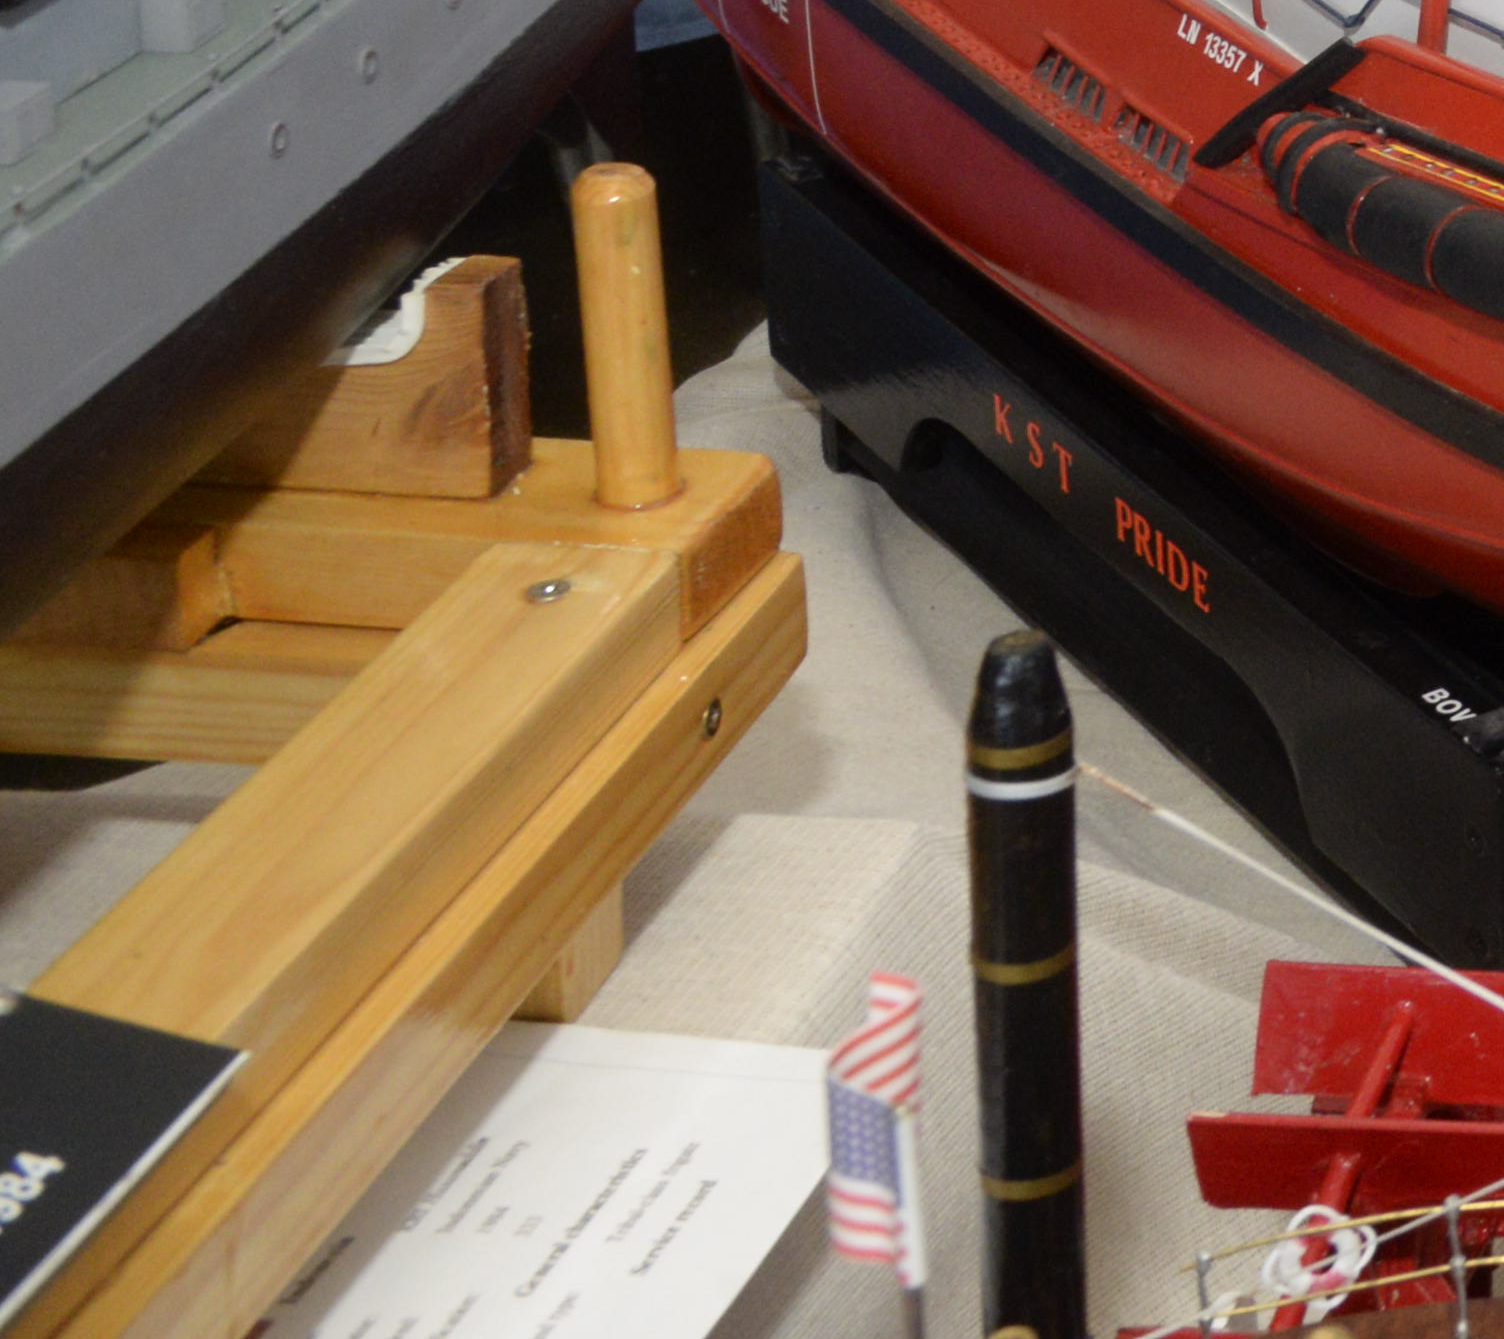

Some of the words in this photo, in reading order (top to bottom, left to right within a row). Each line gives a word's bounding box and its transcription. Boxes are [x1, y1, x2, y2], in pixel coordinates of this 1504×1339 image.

[1177, 13, 1202, 46] LN
[1203, 33, 1248, 73] 13357
[1247, 56, 1263, 87] X
[1114, 496, 1211, 614] PRIDE
[514, 1242, 570, 1297] General
[629, 1225, 682, 1275] Service
[673, 1179, 717, 1220] record
